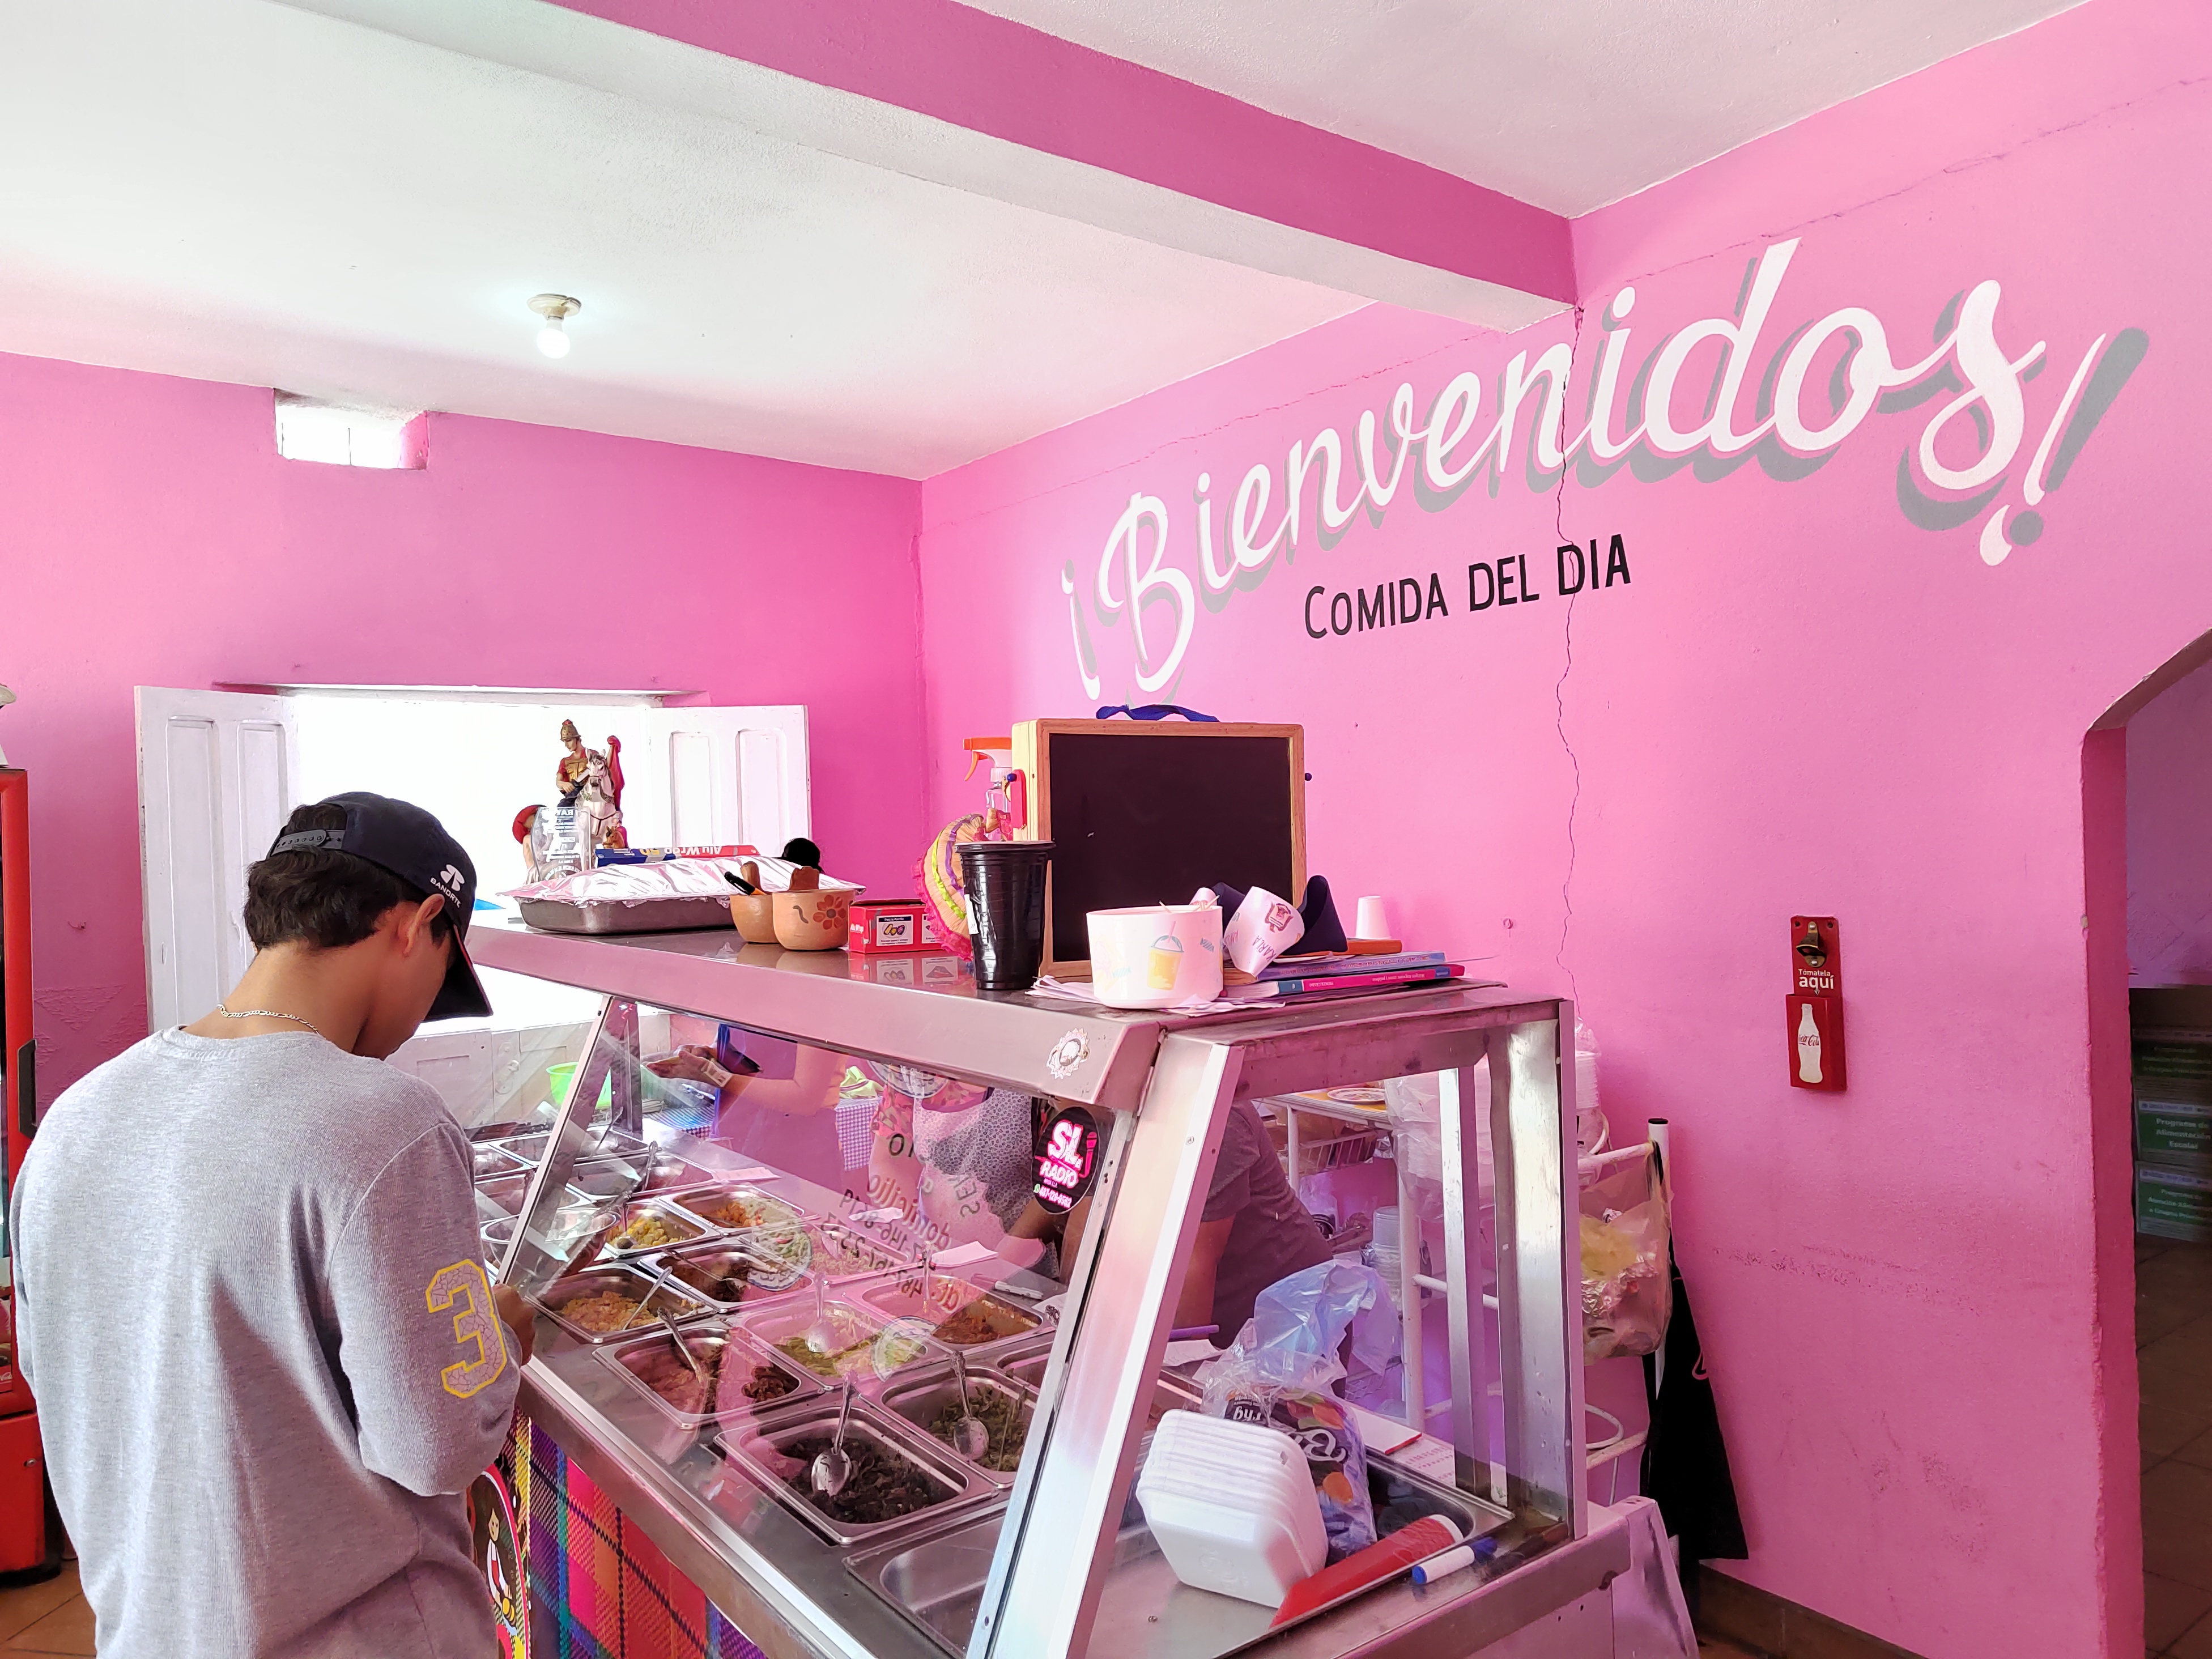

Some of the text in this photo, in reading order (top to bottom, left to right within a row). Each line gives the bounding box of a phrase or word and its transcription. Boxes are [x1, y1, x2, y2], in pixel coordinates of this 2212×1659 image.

[1304, 533, 1632, 639] COMIDA DEL DIA
[430, 877, 461, 908] BANORTE
[1252, 935, 1277, 963] KARLA
[1799, 975, 1834, 990] aquí
[1040, 1160, 1079, 1189] RADIO
[426, 1258, 508, 1399] 3
